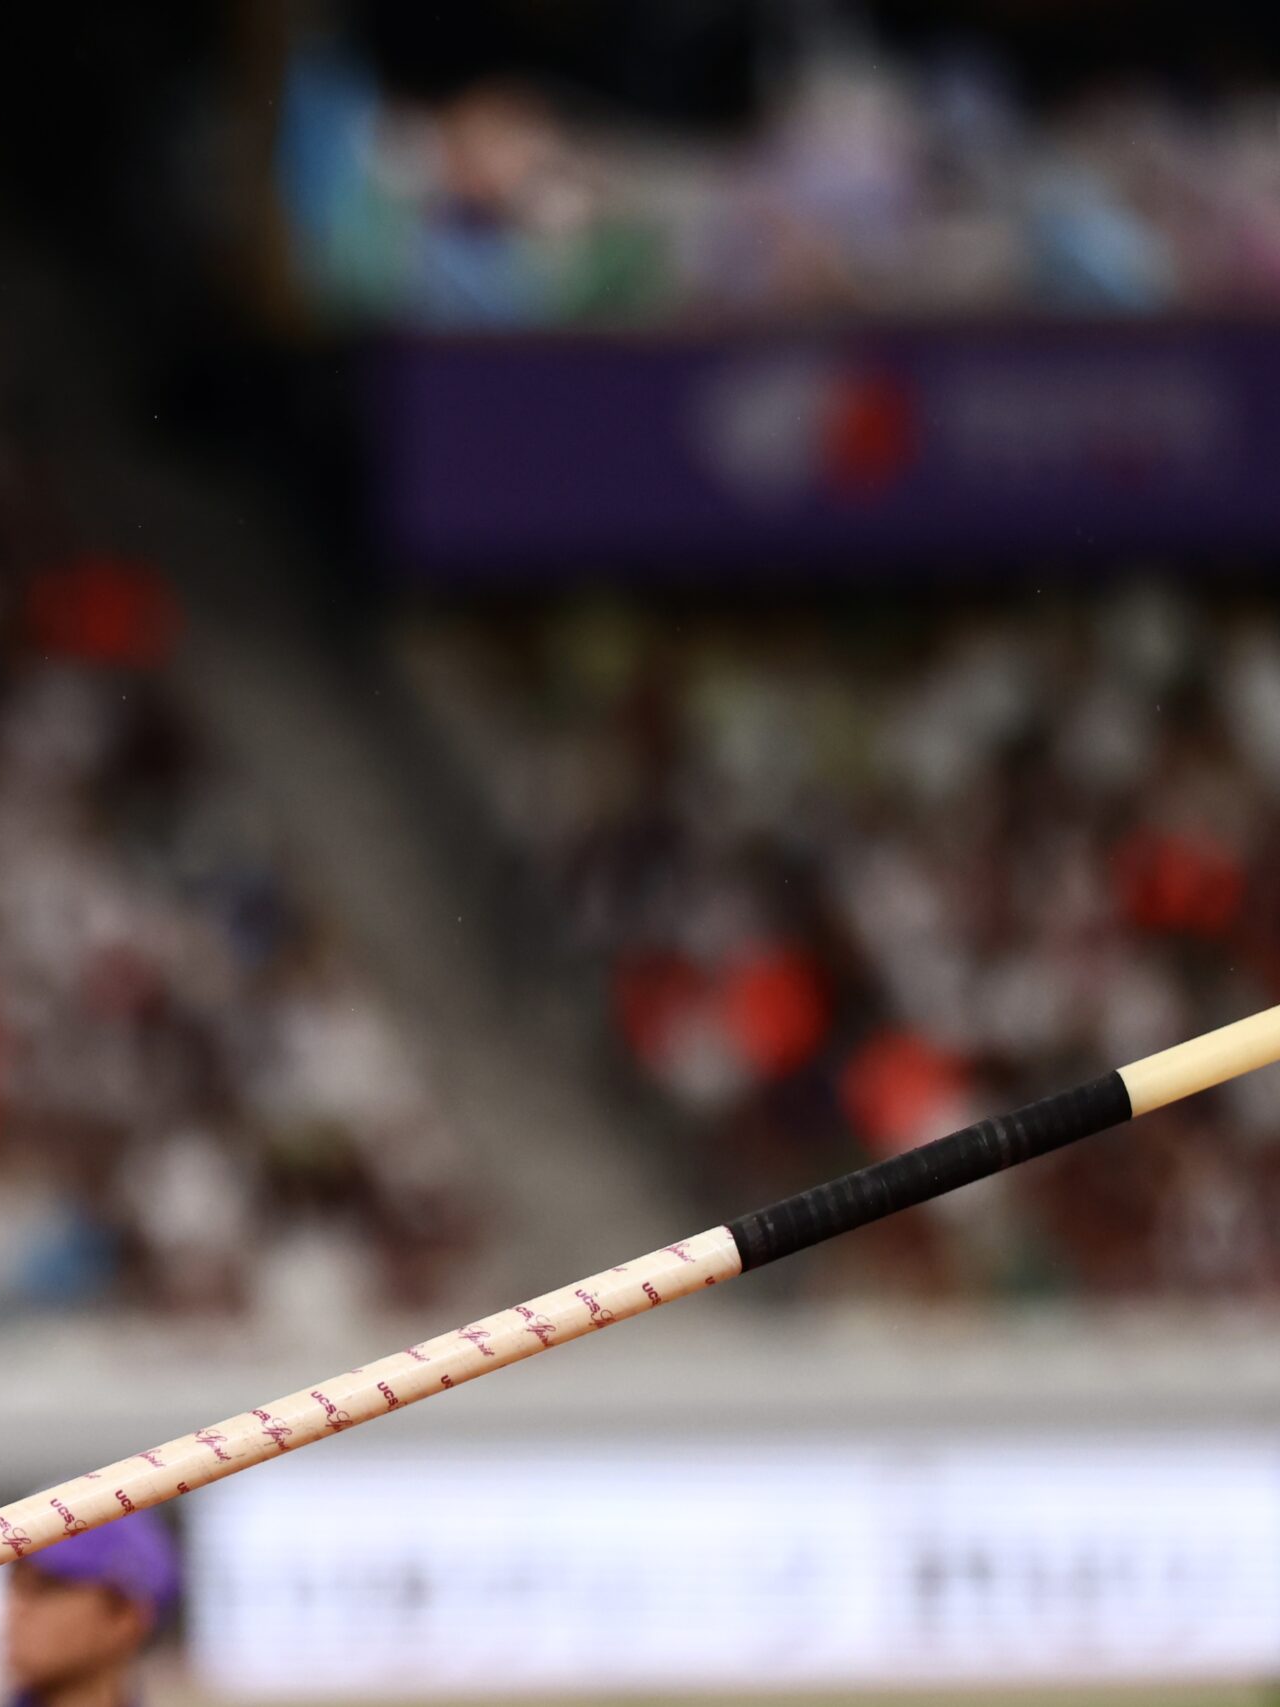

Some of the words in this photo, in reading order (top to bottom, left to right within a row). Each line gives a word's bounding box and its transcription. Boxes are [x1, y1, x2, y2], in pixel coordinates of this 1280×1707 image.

[575, 1289, 600, 1313] UCS
[515, 1306, 534, 1320] CS
[311, 1391, 337, 1414] UCS
[377, 1382, 399, 1406] UCS
[252, 1410, 270, 1421] CS
[50, 1498, 75, 1524] UCS
